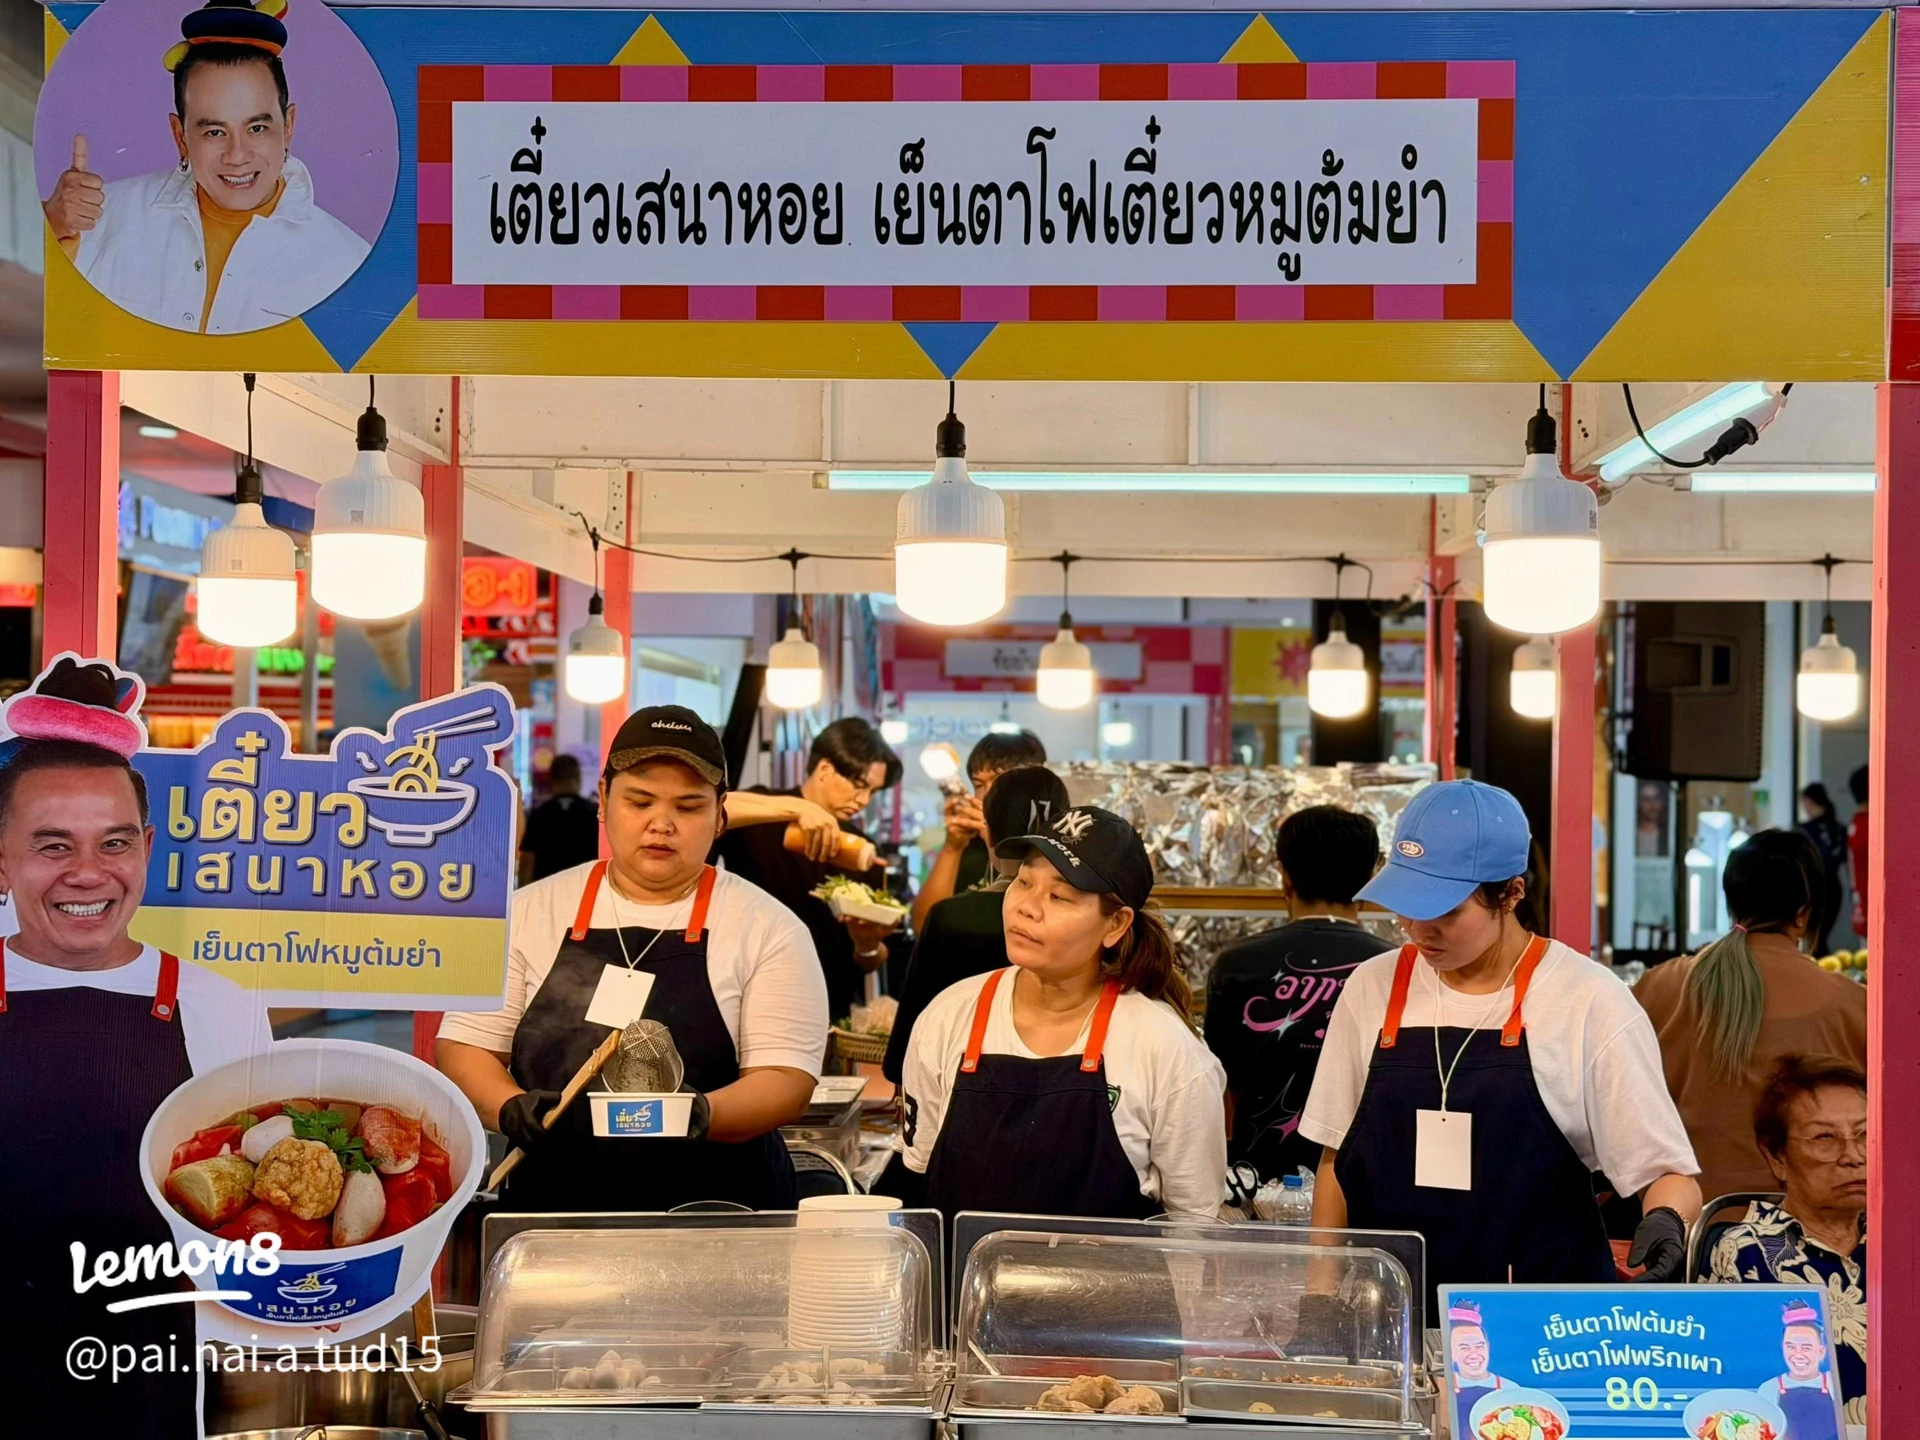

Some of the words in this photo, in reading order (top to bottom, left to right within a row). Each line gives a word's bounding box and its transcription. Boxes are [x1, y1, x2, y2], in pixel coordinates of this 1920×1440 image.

[489, 115, 844, 246] เตี๋ยวเสนาหอย
[874, 114, 1447, 282] เย็นตาโฟเตี๋ยวหมูต้มยำ
[167, 730, 368, 848] เตี๋ยว
[166, 851, 475, 901] เสนาหอย
[193, 930, 442, 975] เย็นตาโฟหมูต้มยำ
[1543, 1305, 1706, 1341] เย็นตาโฟต้มยำ
[1531, 1339, 1723, 1375] เย็นตาโฟพริกเผา
